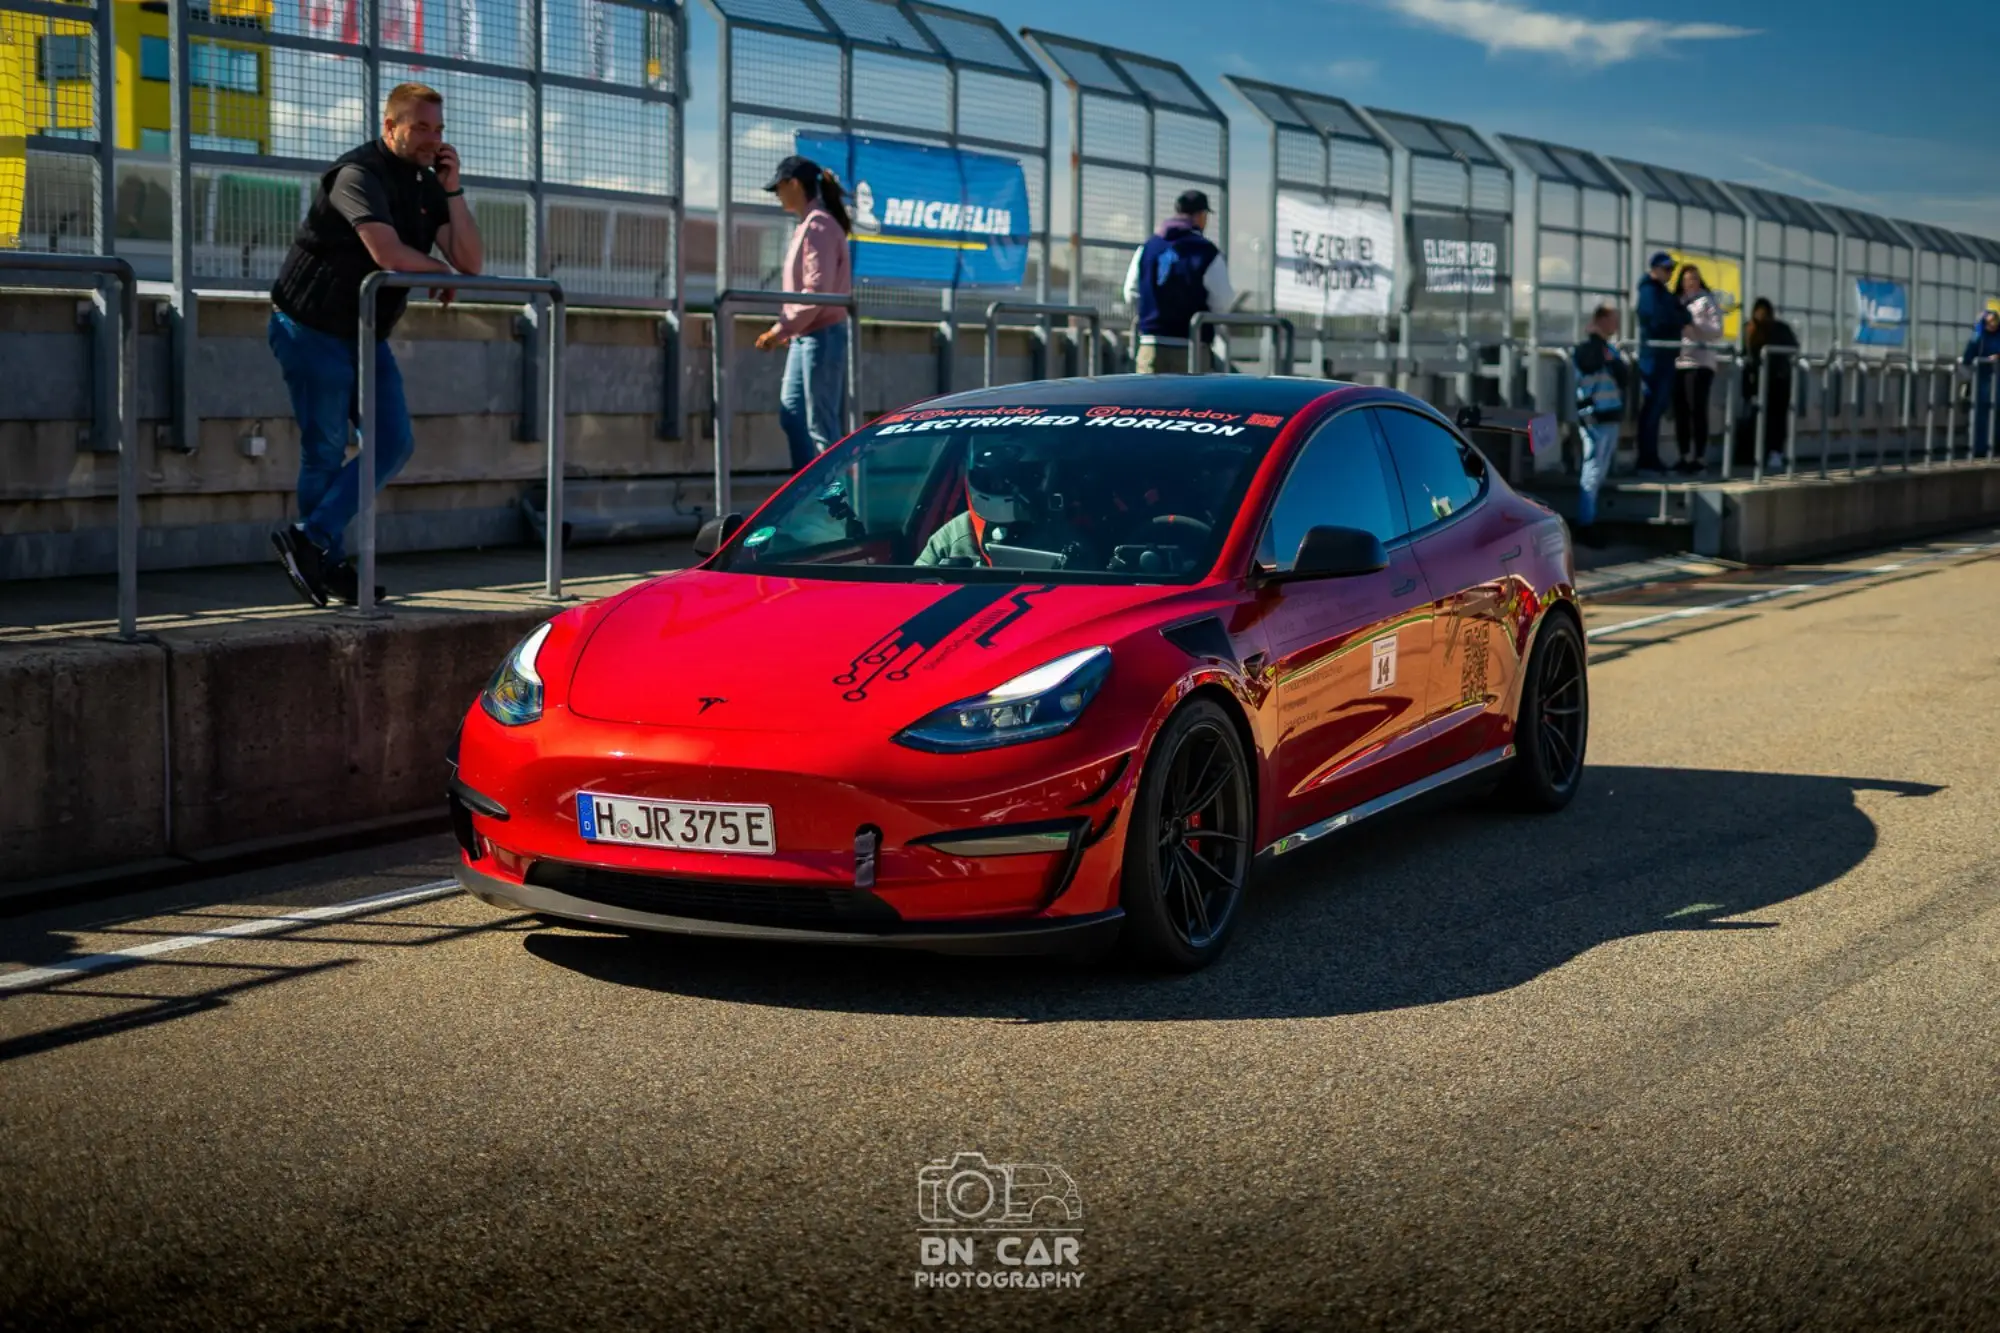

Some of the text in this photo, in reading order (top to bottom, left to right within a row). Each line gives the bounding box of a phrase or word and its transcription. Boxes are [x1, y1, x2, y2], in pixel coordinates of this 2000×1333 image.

[884, 197, 1011, 236] MICHELIN
[875, 415, 1246, 437] ELECTRIFIED HORIZON
[1377, 655, 1391, 685] 14
[595, 802, 616, 836] H
